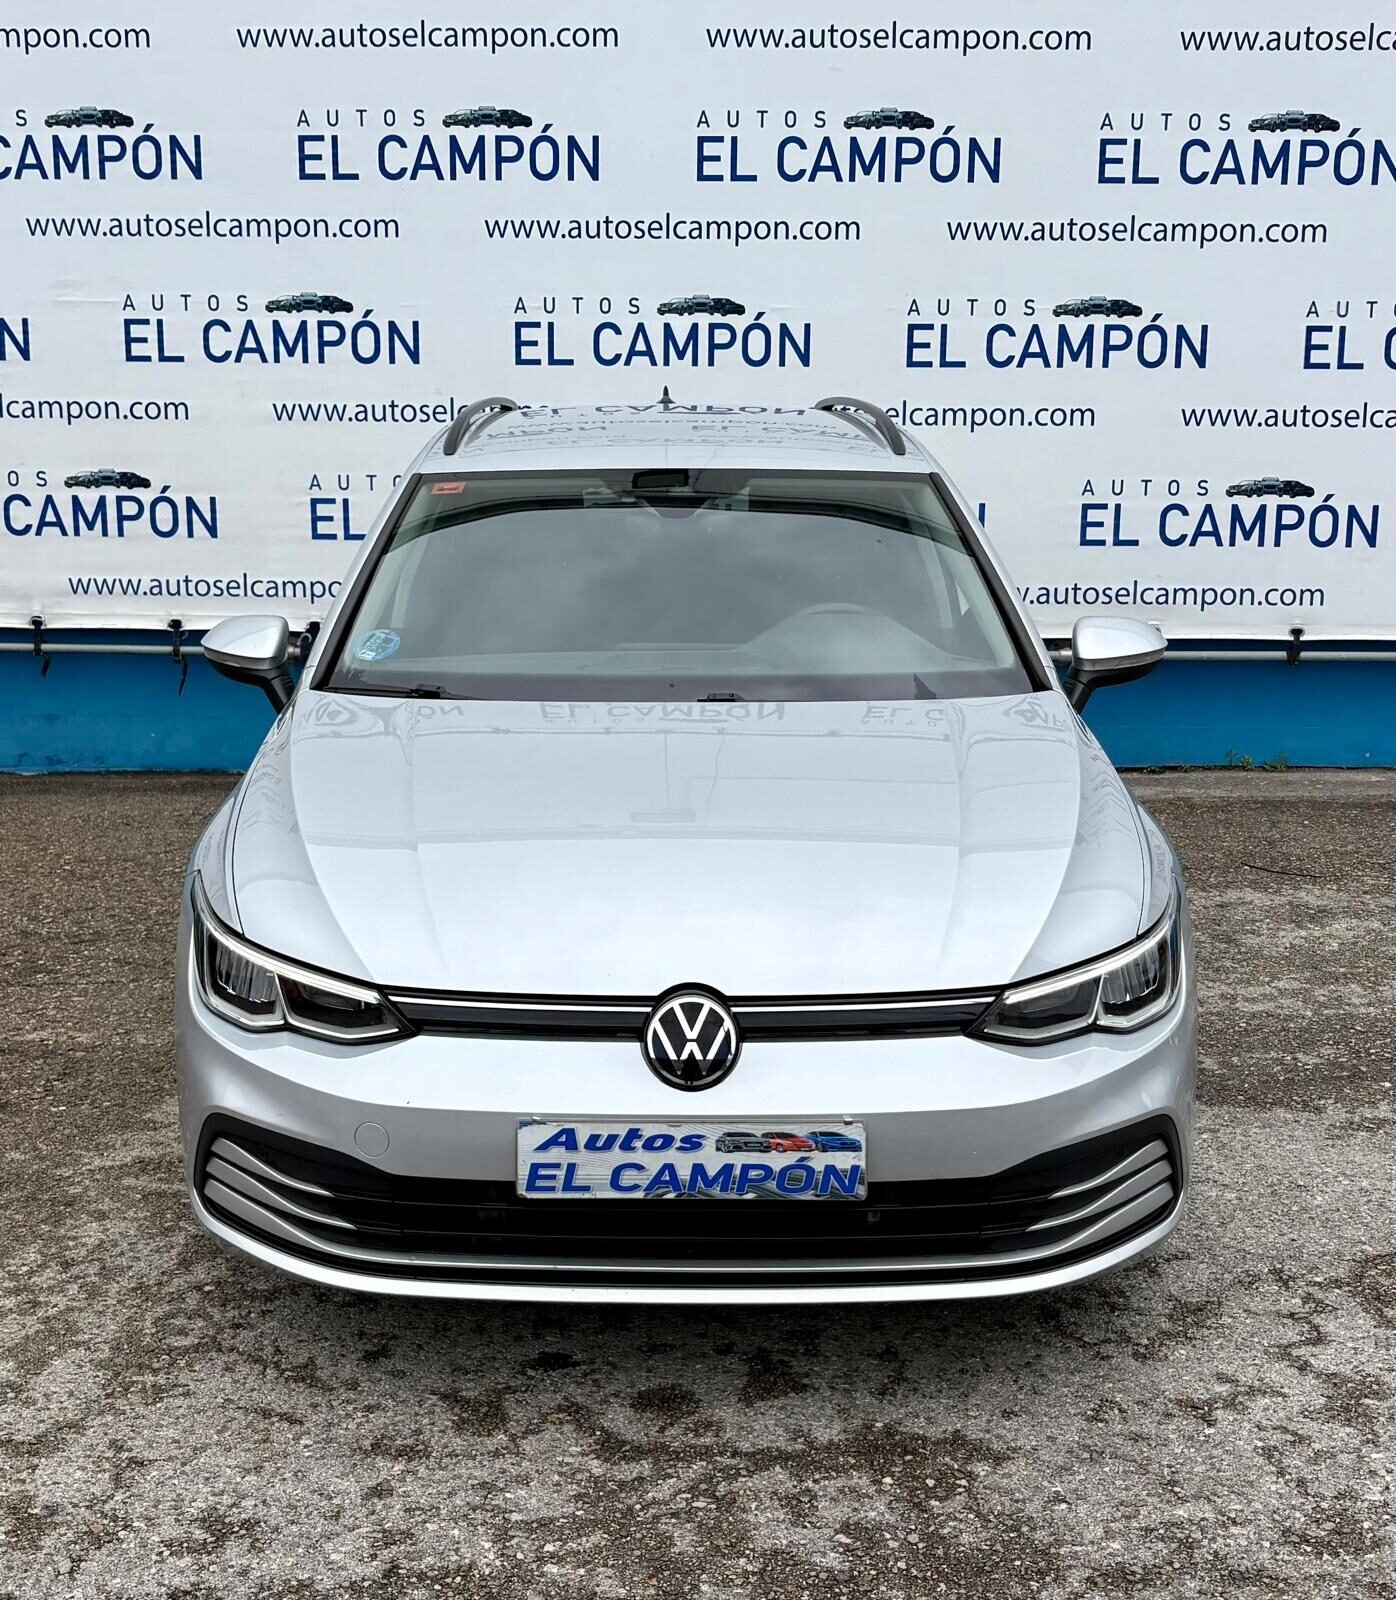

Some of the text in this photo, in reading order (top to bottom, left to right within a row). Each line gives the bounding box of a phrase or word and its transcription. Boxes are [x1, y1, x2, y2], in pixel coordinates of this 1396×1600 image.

[236, 19, 619, 55] www.autoselcampon.com
[706, 20, 1092, 57] www.autoselcampon.com
[1180, 22, 1396, 52] www.autoselc
[296, 108, 425, 128] AUTOS
[696, 109, 826, 129] AUTOS
[1099, 112, 1231, 132] AUTOS
[297, 123, 600, 182] EL CAMPÓN
[696, 125, 1002, 184] EL CAMPÓN
[1097, 138, 1160, 185] EL
[25, 210, 399, 245] www.autoselcampon.com
[484, 212, 861, 247] www.autoselcampon.com
[946, 214, 1327, 249] www.autoselcampon.com
[122, 293, 249, 312] AUTOS
[513, 296, 640, 315] AUTOS
[907, 298, 1036, 317] AUTOS
[1305, 300, 1396, 319] AUT
[123, 308, 420, 365] EL CAMPÓN
[514, 311, 811, 368] EL CAMPÓN
[905, 312, 1209, 369] EL CAMPÓN
[1303, 325, 1365, 370] EL
[1081, 479, 1209, 497] AUTOS
[3, 484, 219, 539] CAMPÓN
[308, 495, 368, 543] EL
[1079, 493, 1380, 549] EL CAMPÓN
[534, 1126, 707, 1153] Autos
[525, 1156, 862, 1195] EL CAMPÓN
